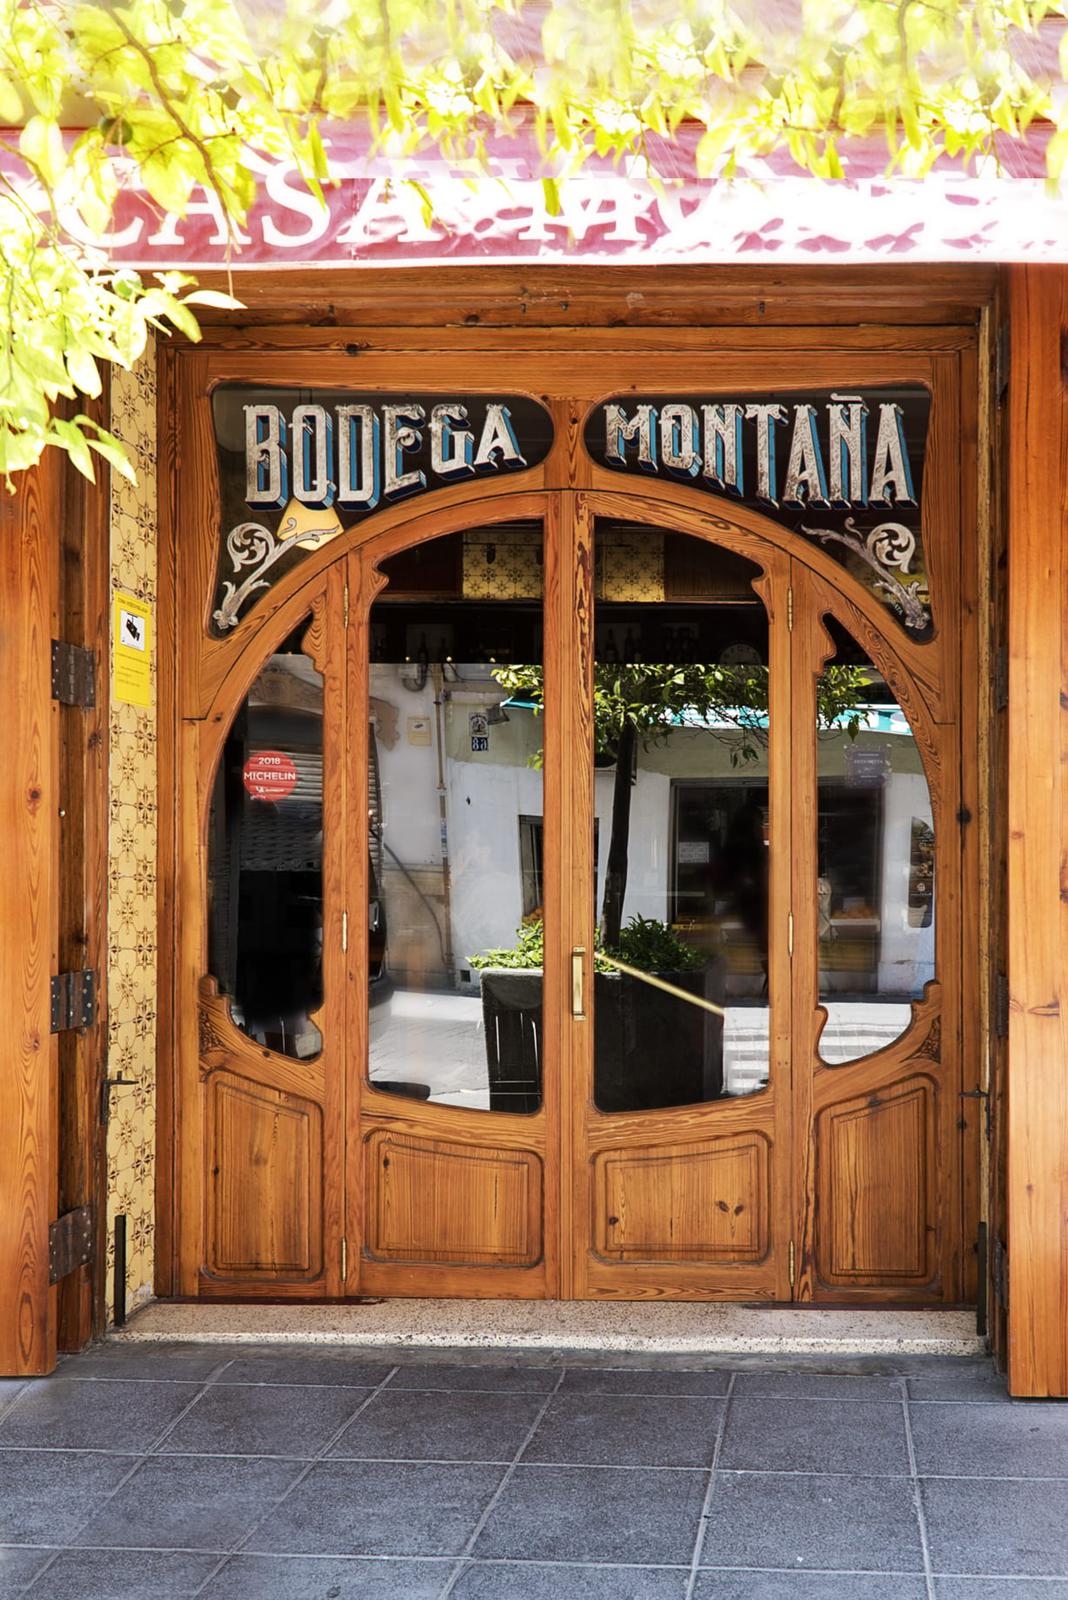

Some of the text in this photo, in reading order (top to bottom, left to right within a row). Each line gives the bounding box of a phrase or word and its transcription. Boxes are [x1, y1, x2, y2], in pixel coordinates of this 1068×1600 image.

[54, 156, 444, 249] CASA
[243, 393, 918, 510] BODEGA MONTAÑA
[244, 771, 296, 780] MICHELIN
[258, 757, 281, 765] 2018
